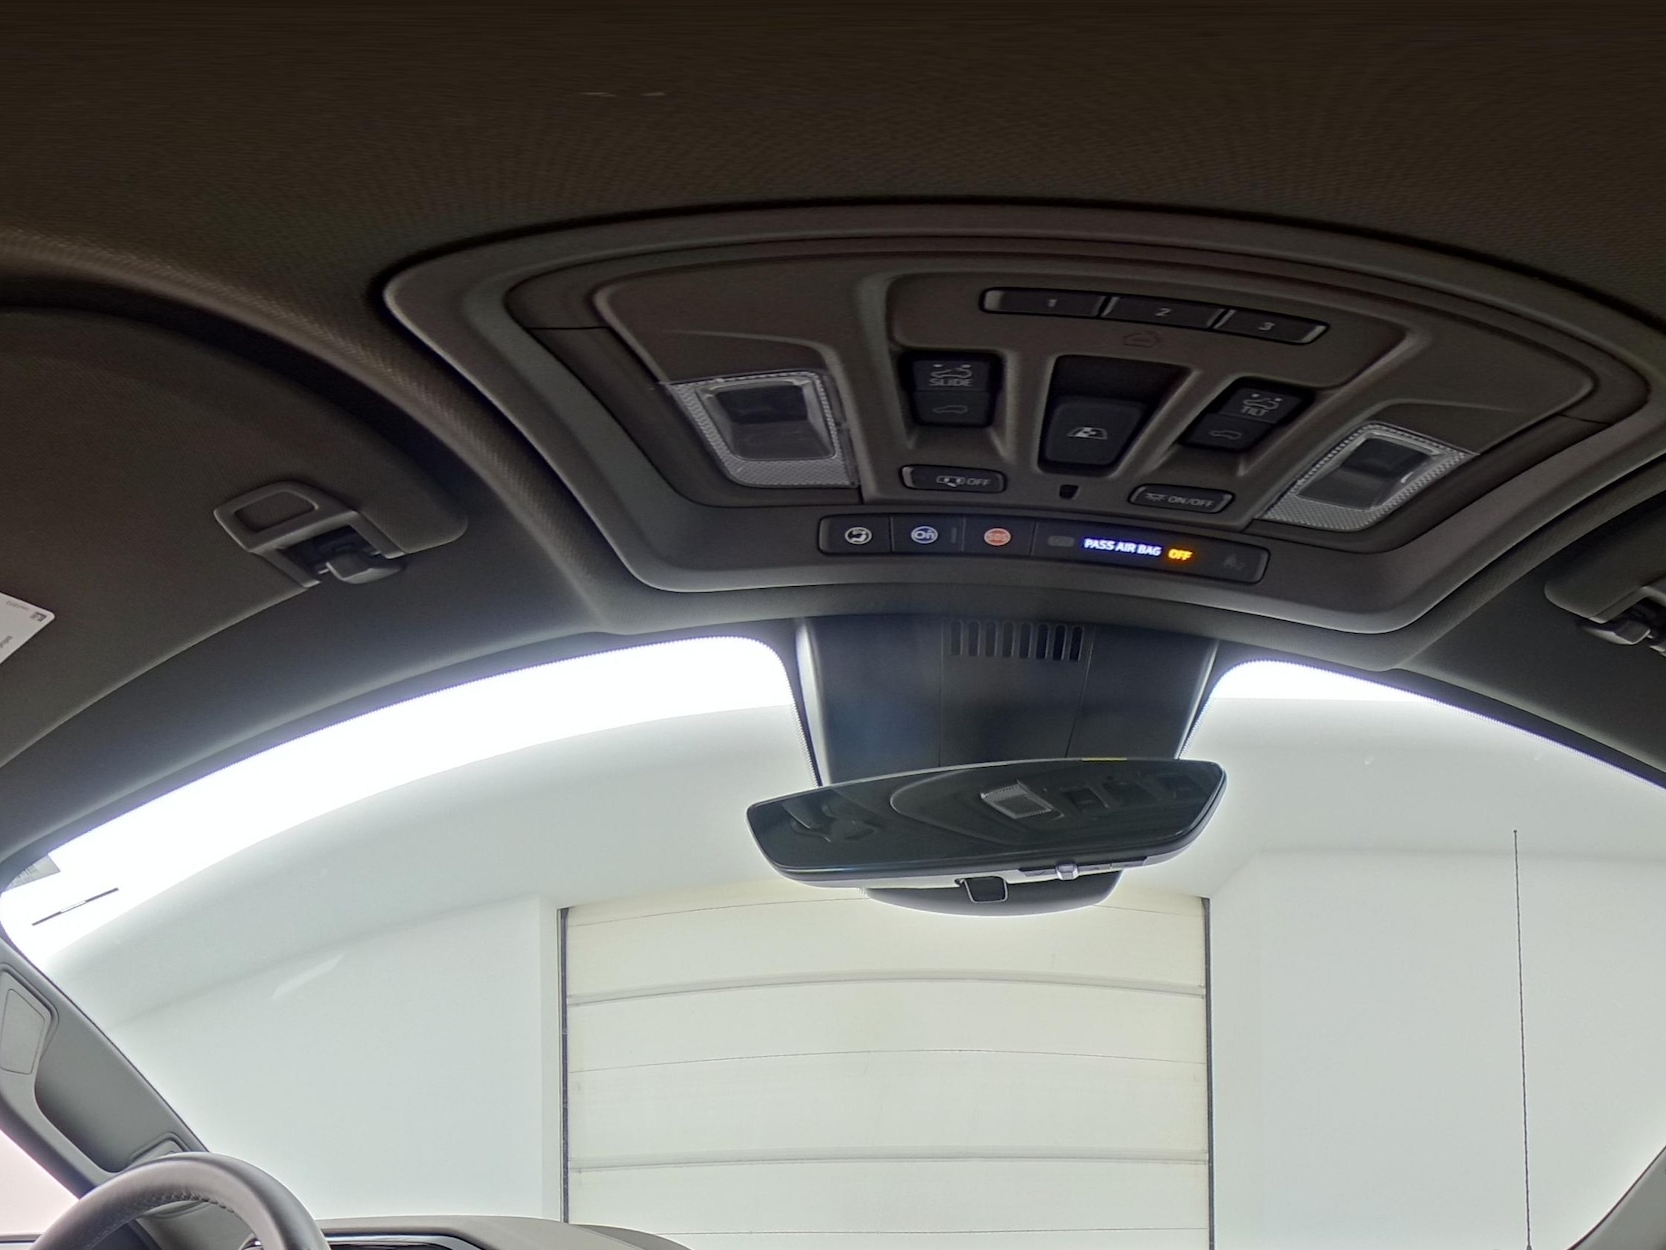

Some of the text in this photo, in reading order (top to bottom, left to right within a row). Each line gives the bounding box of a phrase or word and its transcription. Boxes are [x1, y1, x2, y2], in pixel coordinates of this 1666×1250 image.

[1156, 307, 1172, 317] 2
[1258, 321, 1275, 331] 3
[929, 378, 973, 387] SLIDE
[1241, 406, 1269, 416] TILT
[967, 478, 990, 486] OFF
[1168, 496, 1214, 508] ON/OFF
[1084, 538, 1115, 551] PASS
[1115, 541, 1135, 553] AIR
[1137, 543, 1161, 556] BAG
[1168, 548, 1193, 560] OFF
